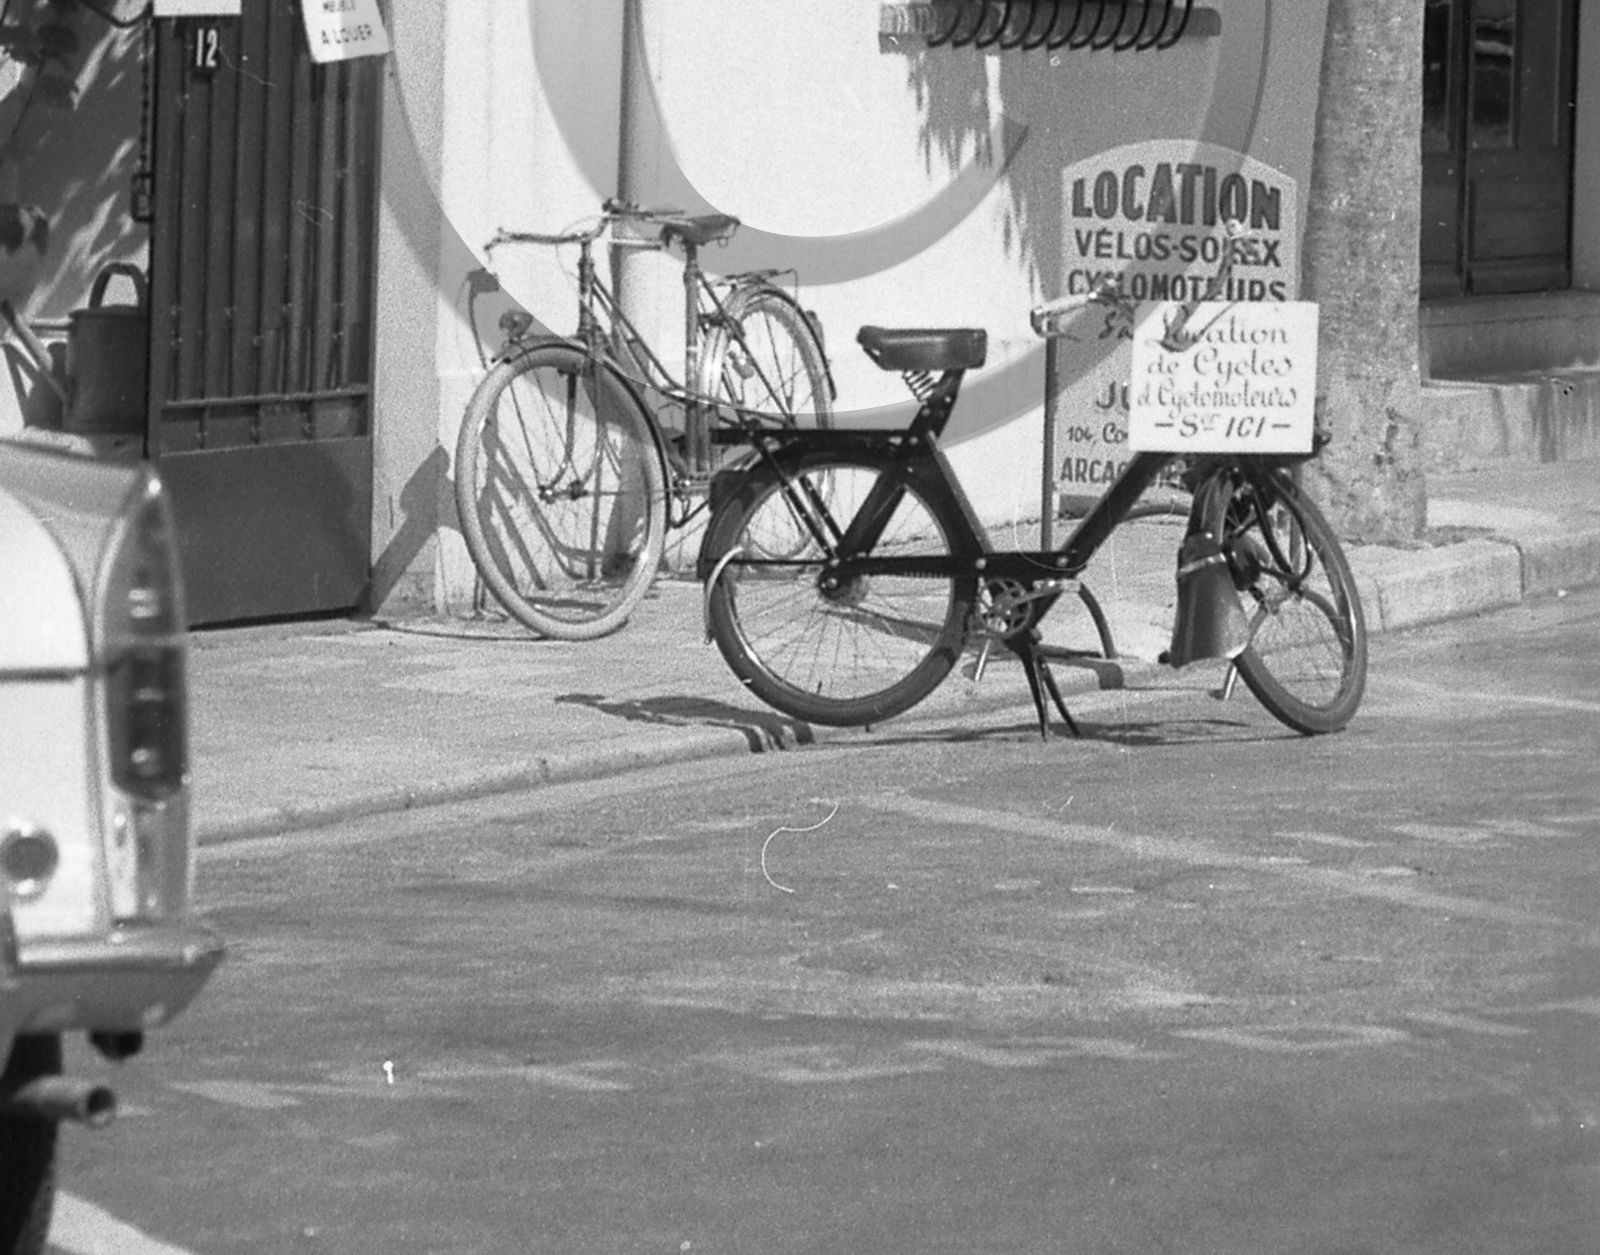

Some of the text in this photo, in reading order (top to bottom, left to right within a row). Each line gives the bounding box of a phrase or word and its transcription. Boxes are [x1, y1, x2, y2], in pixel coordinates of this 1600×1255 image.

[196, 28, 218, 68] 12
[333, 23, 373, 44] LOUER
[1072, 163, 1281, 231] LOCATION
[1147, 347, 1293, 387] de Cycles
[1157, 377, 1298, 420] Cyclomoteurs
[1102, 421, 1129, 444] Co
[1224, 415, 1267, 439] ICI
